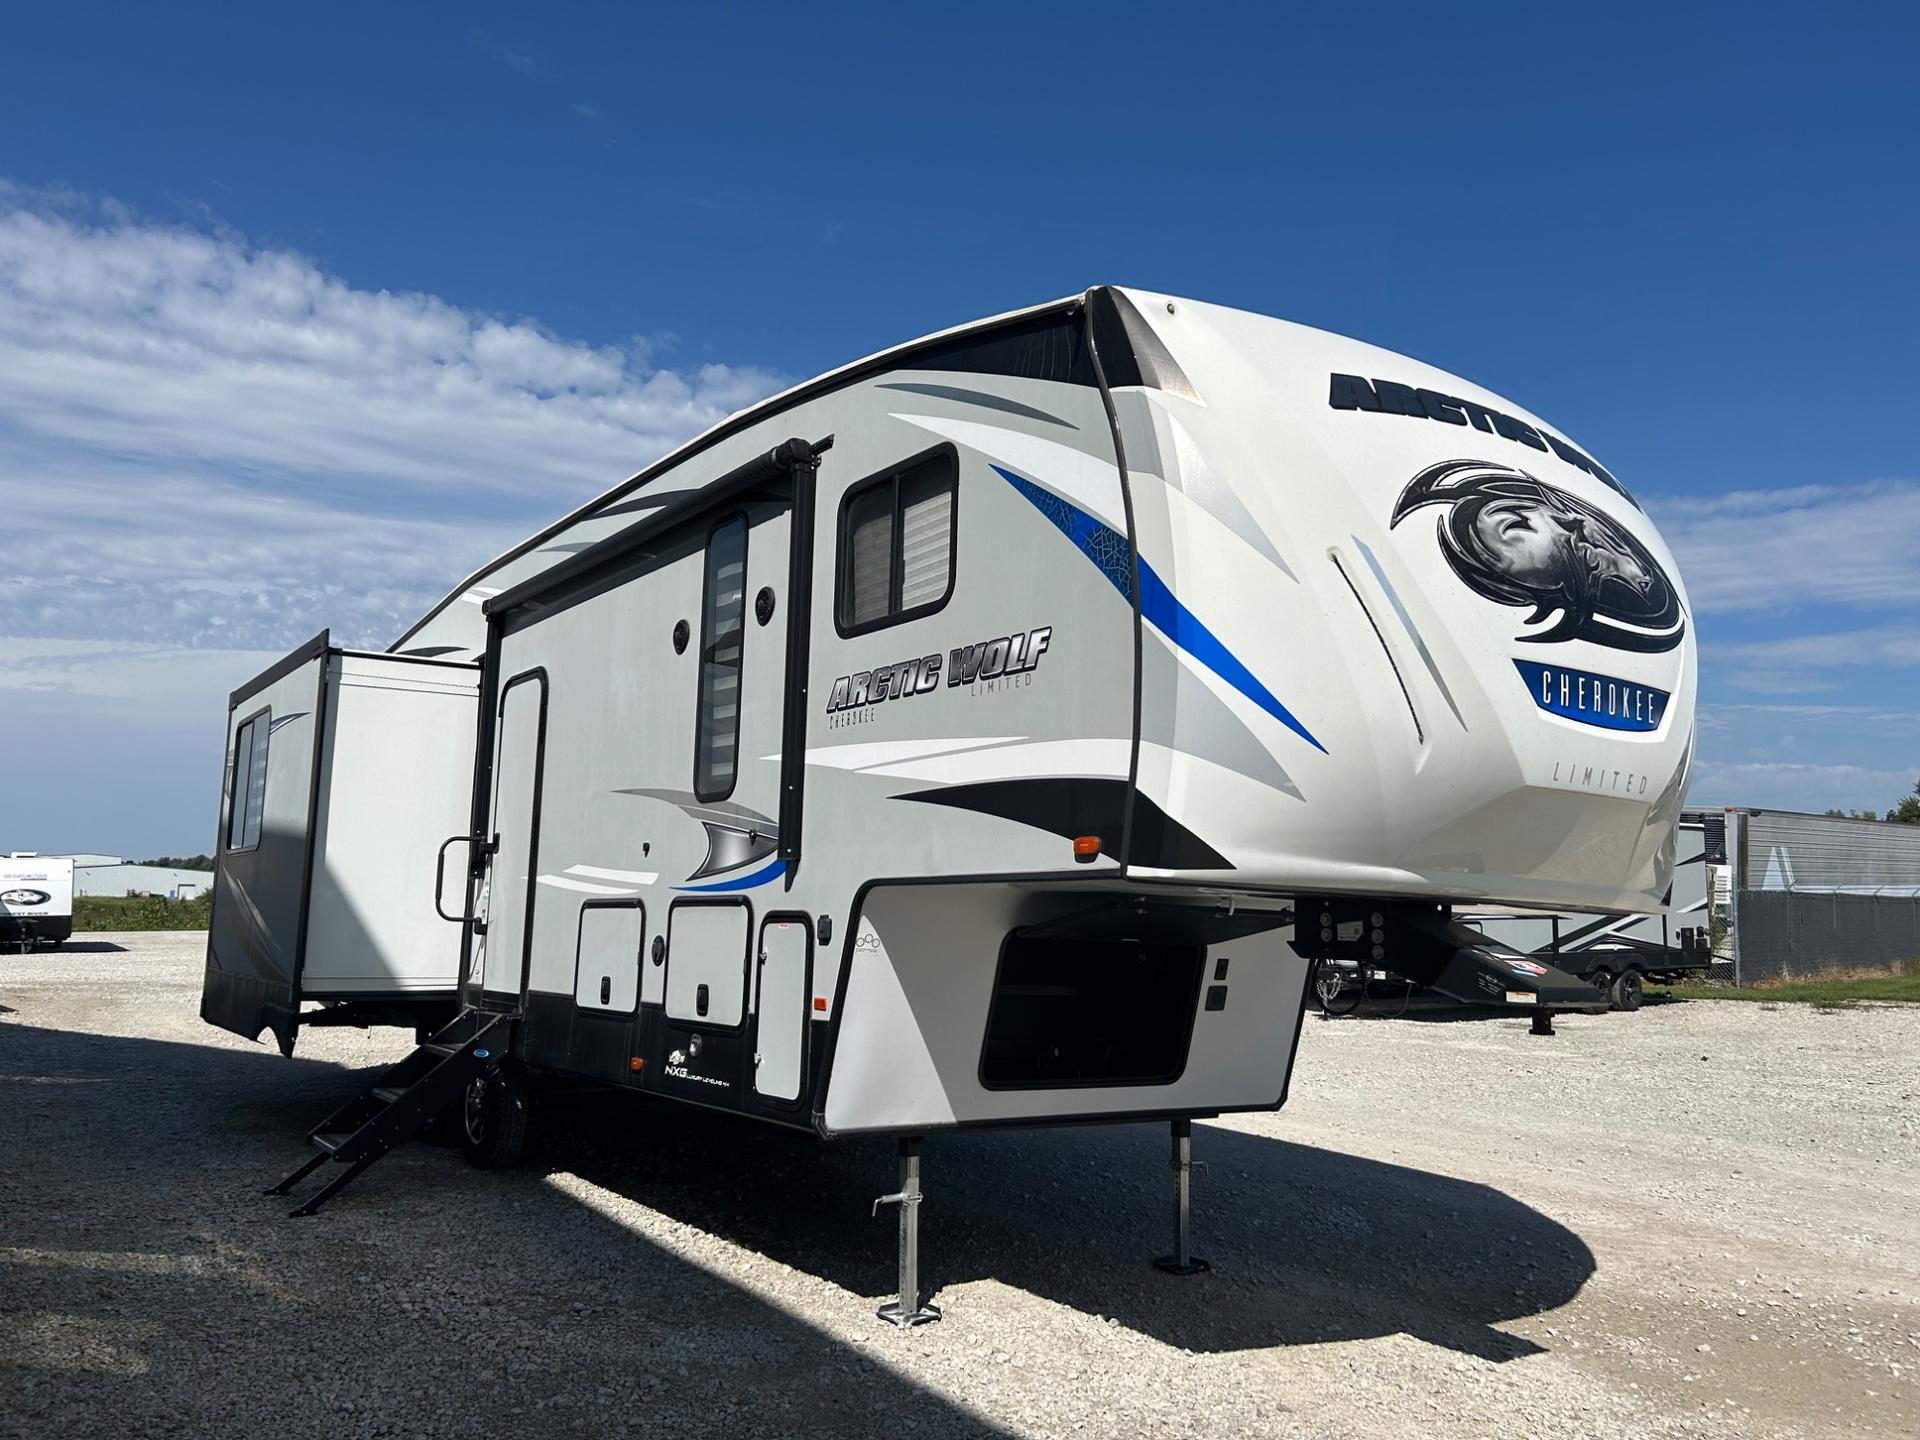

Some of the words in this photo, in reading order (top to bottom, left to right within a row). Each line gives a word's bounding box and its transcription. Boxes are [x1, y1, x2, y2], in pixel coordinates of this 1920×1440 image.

[1329, 372, 1548, 453] ARCTIC
[827, 653, 942, 714] ARCTIC
[947, 626, 1053, 688] WOLF
[971, 673, 1032, 697] LIMITED
[1542, 670, 1654, 724] CHEROKEE
[829, 707, 875, 730] CHEROKEE
[1552, 761, 1648, 794] LIMITED
[664, 1065, 688, 1078] NXG
